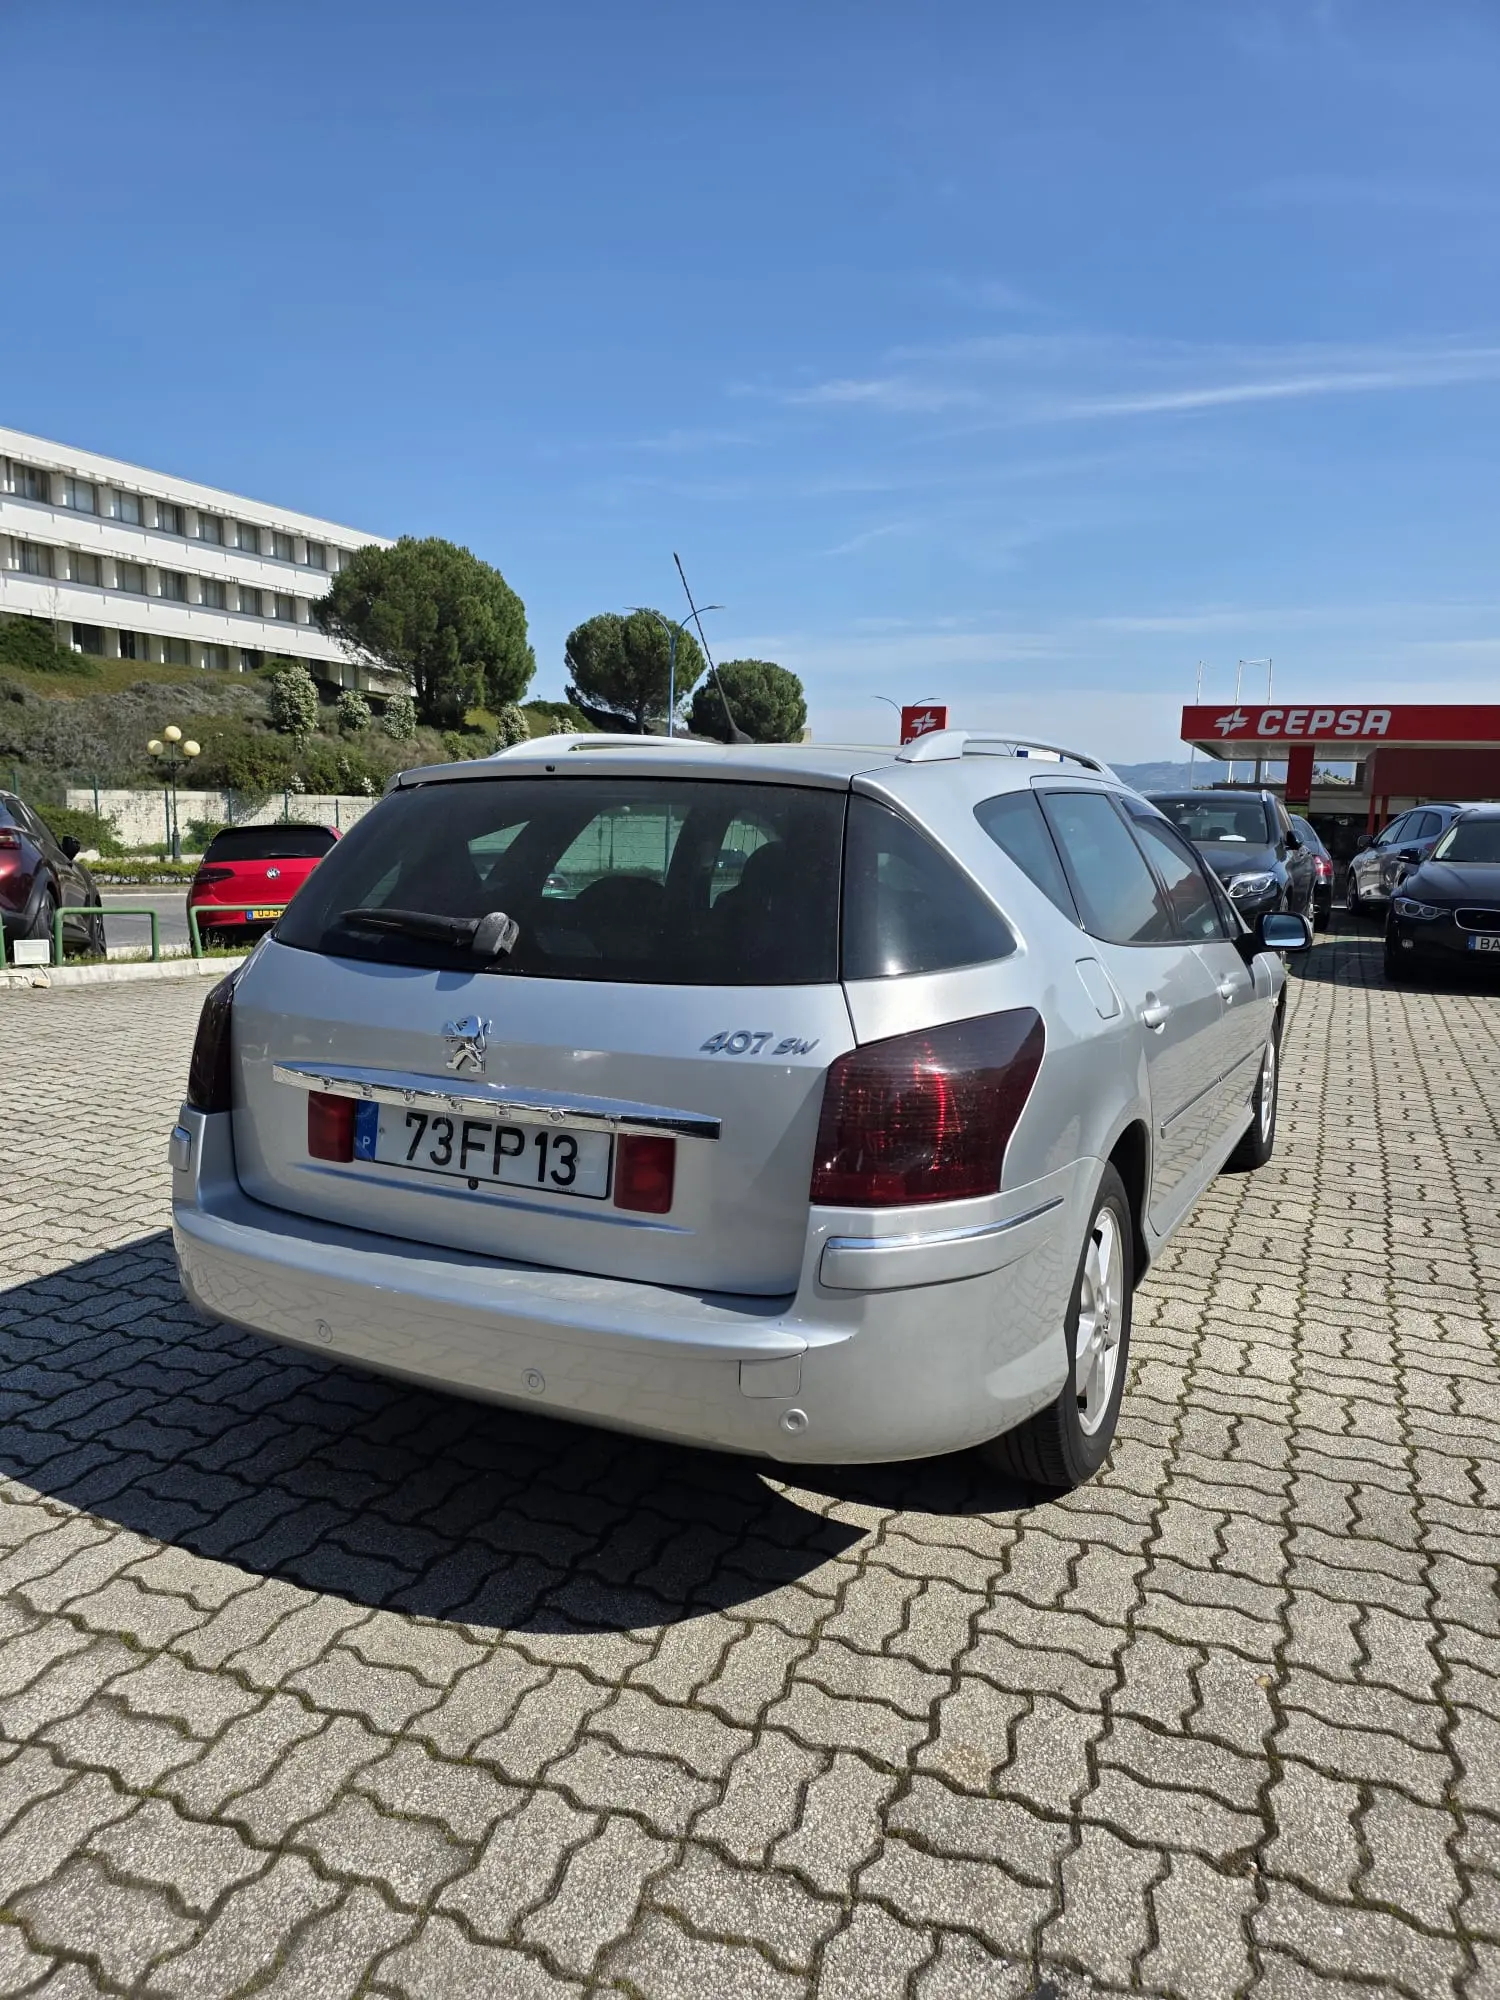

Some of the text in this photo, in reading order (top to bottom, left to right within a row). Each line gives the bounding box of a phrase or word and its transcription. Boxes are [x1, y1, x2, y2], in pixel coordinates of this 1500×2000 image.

[1257, 709, 1392, 735] CEPSA
[699, 1030, 774, 1055] 407
[362, 1135, 371, 1149] P
